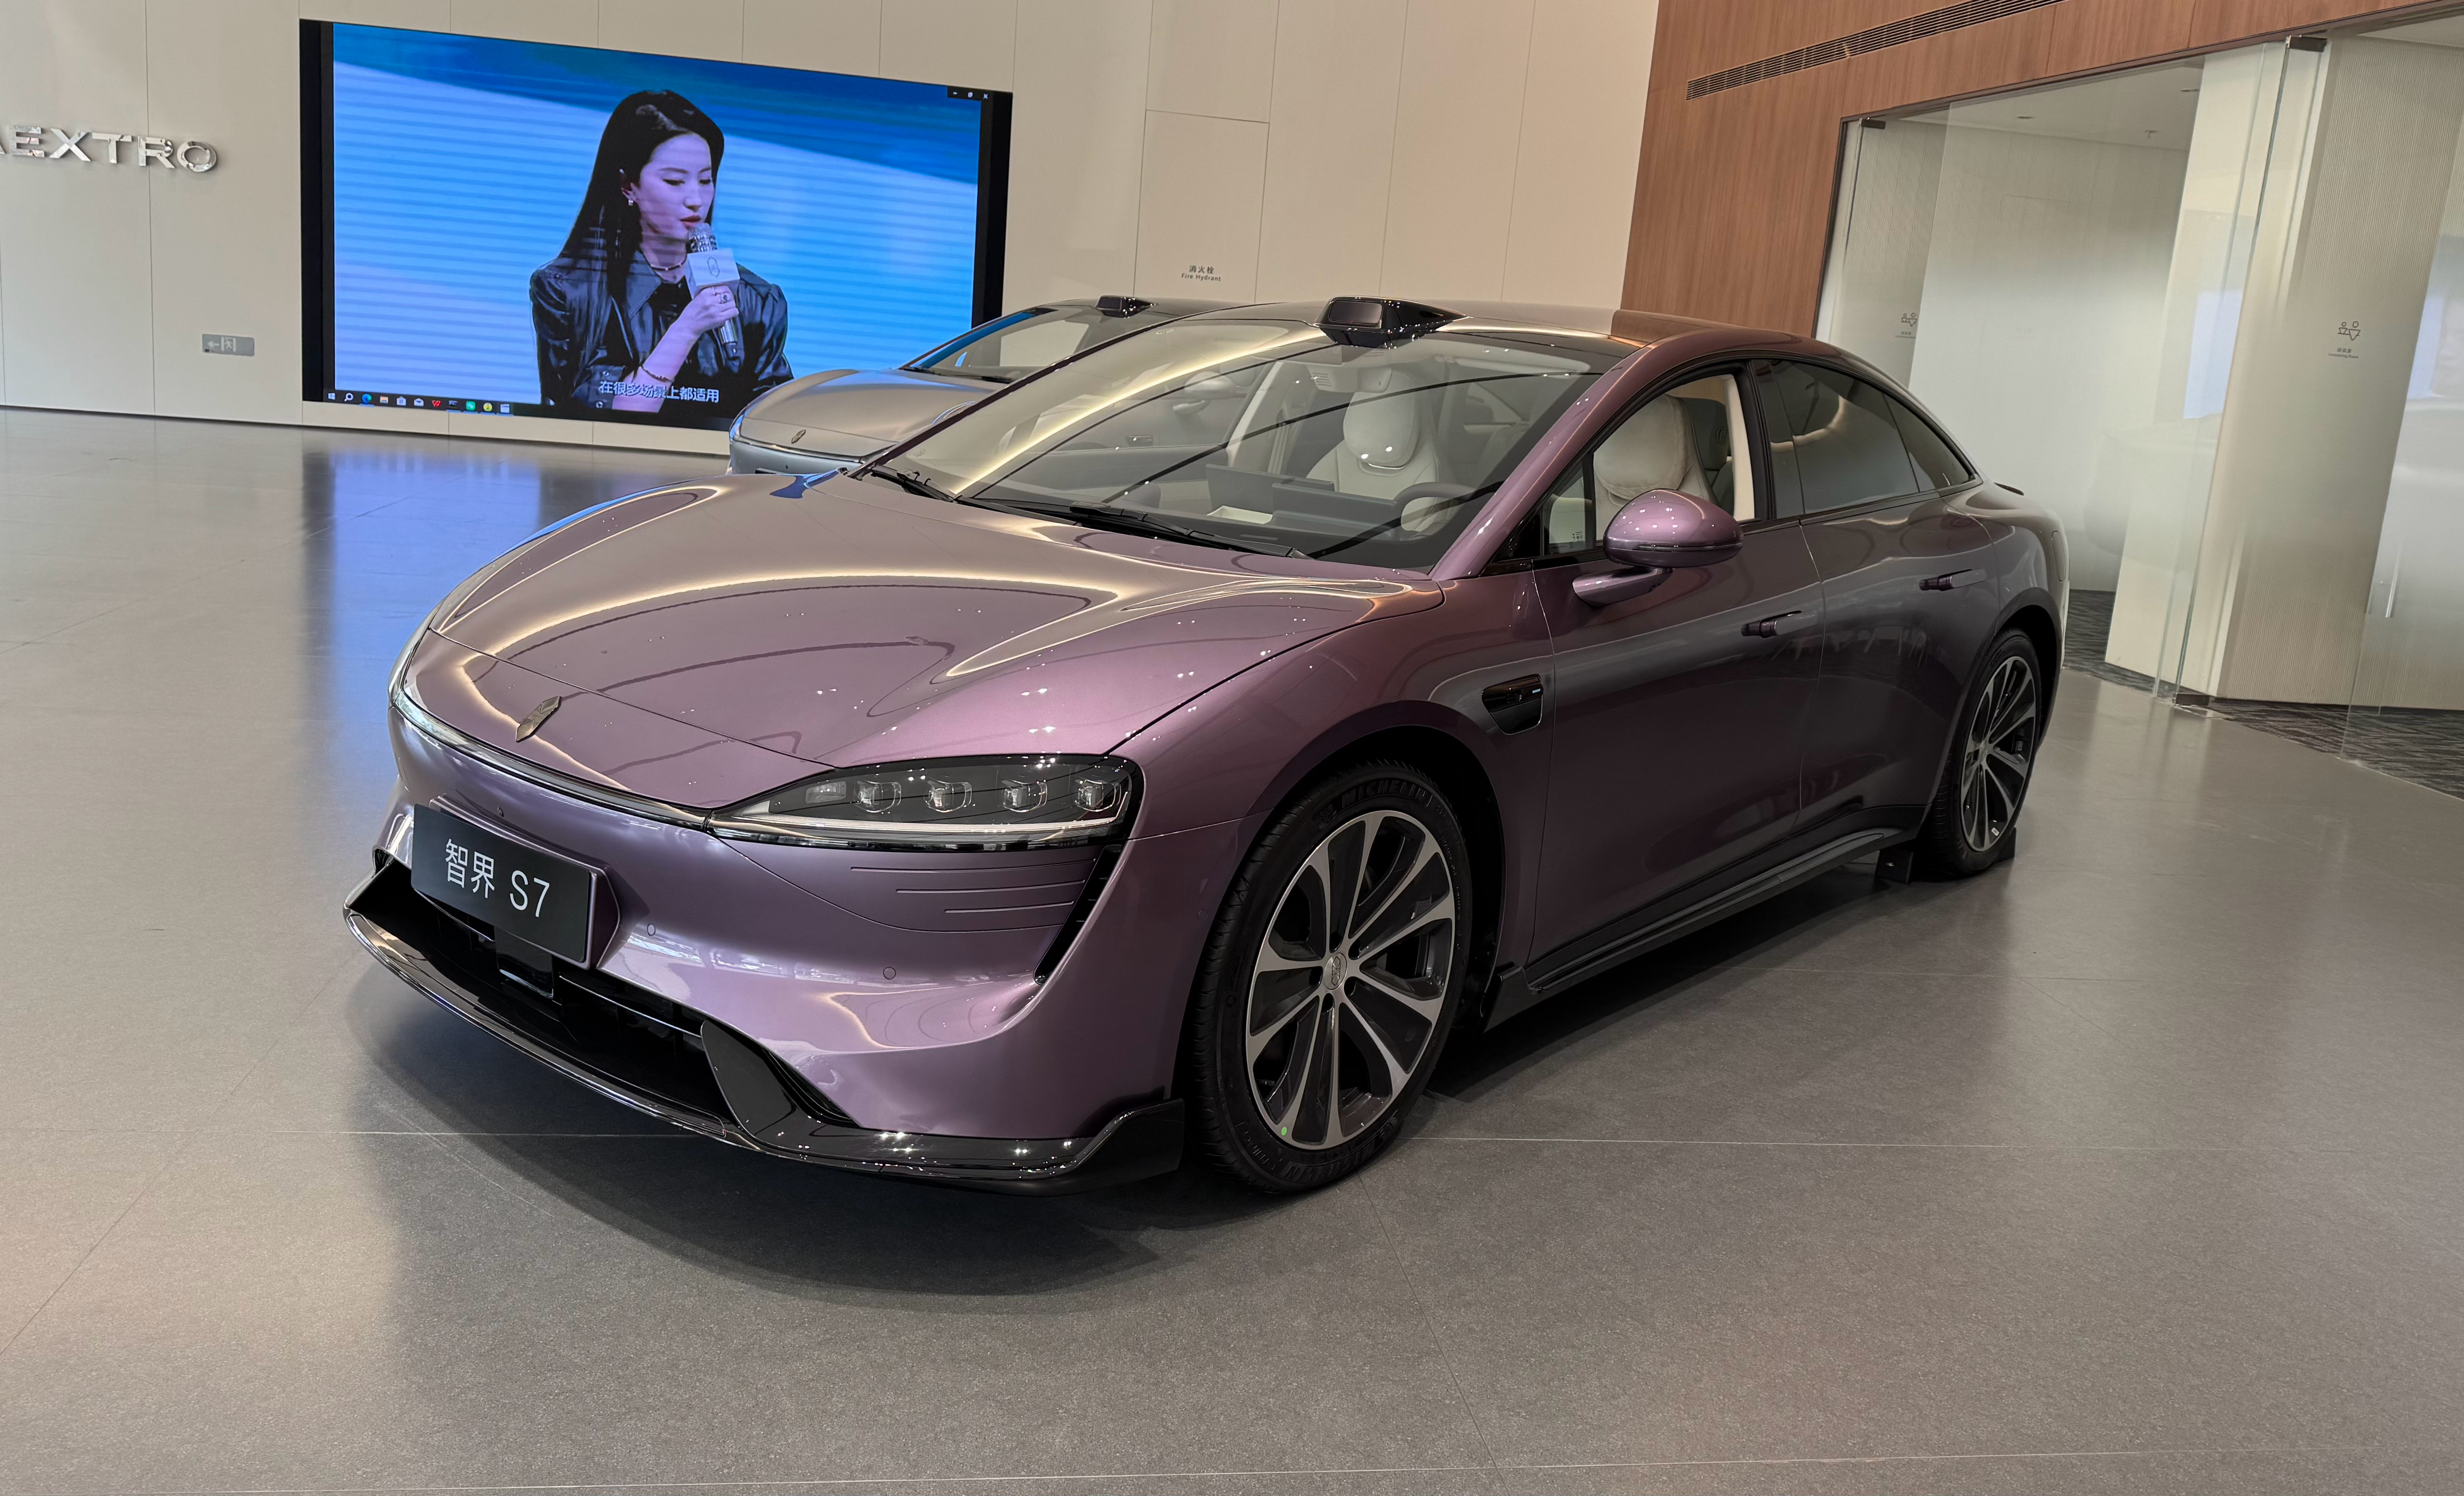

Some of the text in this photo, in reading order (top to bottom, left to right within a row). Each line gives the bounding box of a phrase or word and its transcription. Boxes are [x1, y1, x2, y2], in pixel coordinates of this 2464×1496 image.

[0, 126, 217, 172] EXTRO
[1189, 265, 1214, 274] 消火栓
[598, 380, 719, 403] 在很多场景上都适用
[445, 839, 550, 917] 智界 S7
